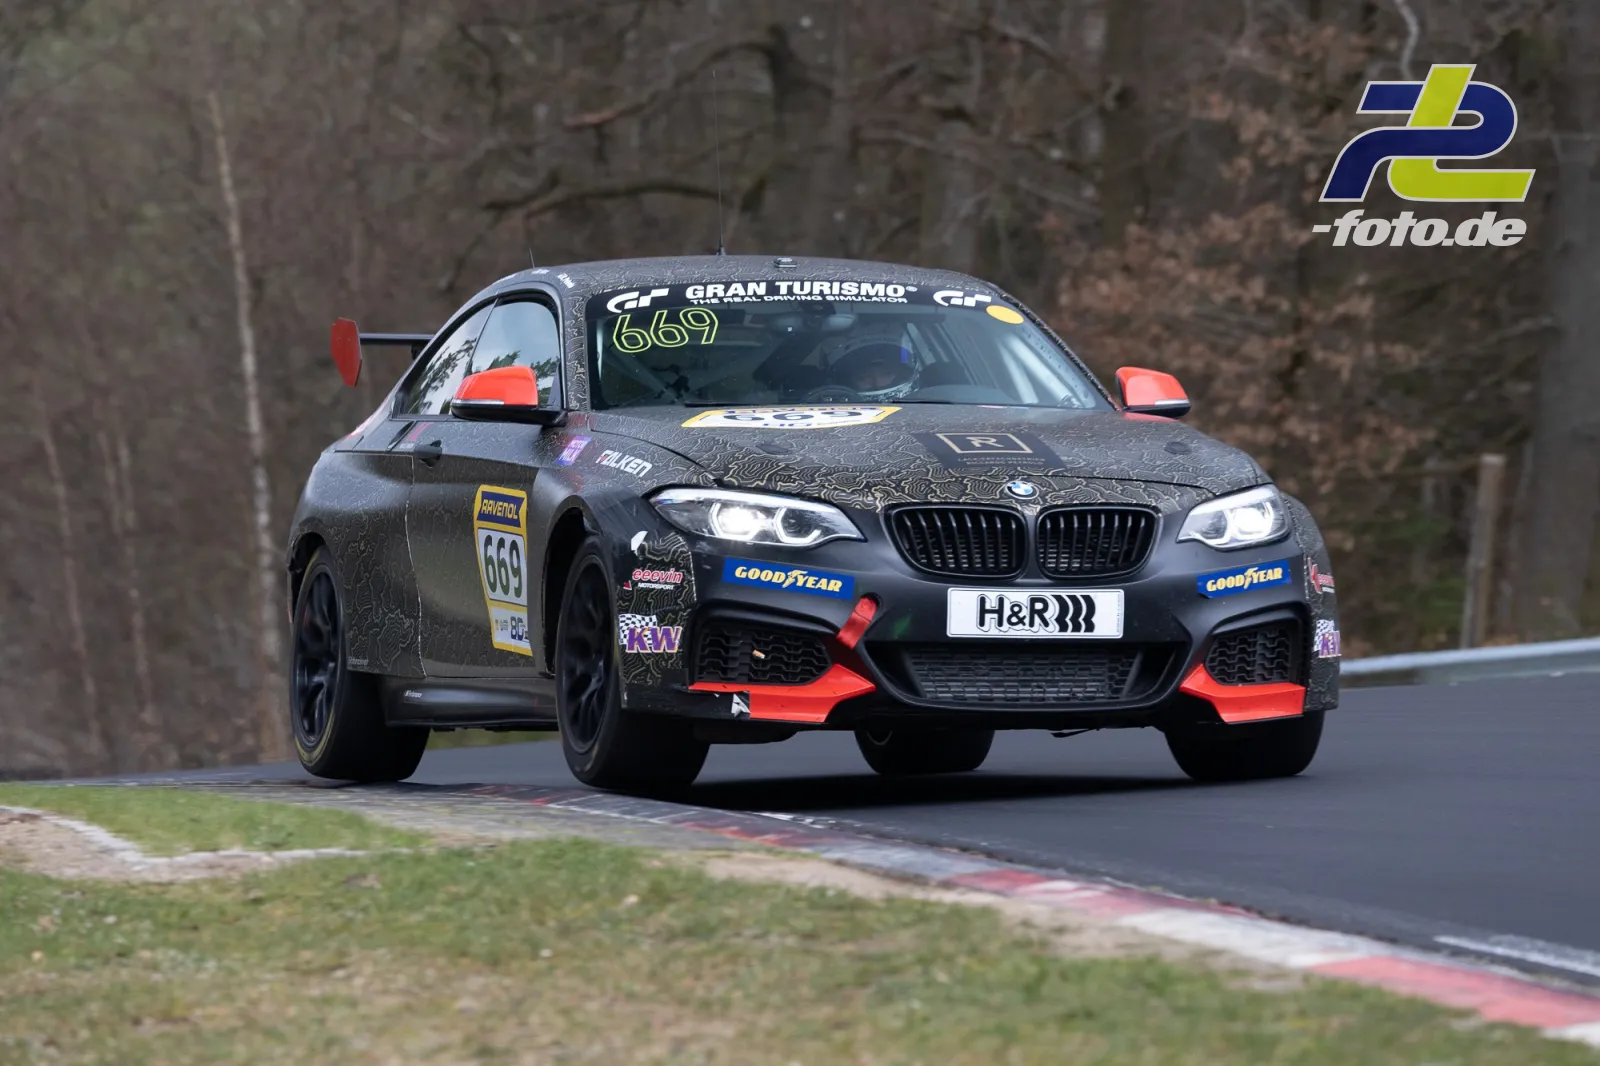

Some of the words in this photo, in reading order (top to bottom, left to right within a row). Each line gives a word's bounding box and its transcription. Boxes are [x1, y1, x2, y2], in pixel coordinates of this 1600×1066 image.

[686, 281, 767, 299] GRAN
[690, 298, 721, 306] THE
[826, 295, 908, 304] SIMULATOR
[612, 307, 719, 353] 669
[723, 411, 862, 422] 669
[965, 436, 1005, 448] R
[596, 449, 653, 478] FALKEN
[480, 498, 519, 520] RAVENOL
[483, 534, 523, 599] 669
[734, 566, 843, 592] GOODYEAR
[1206, 566, 1284, 592] GOODYEAR
[637, 582, 675, 590] MOTORSPORT
[976, 594, 1053, 631] H&R
[626, 626, 683, 653] KW
